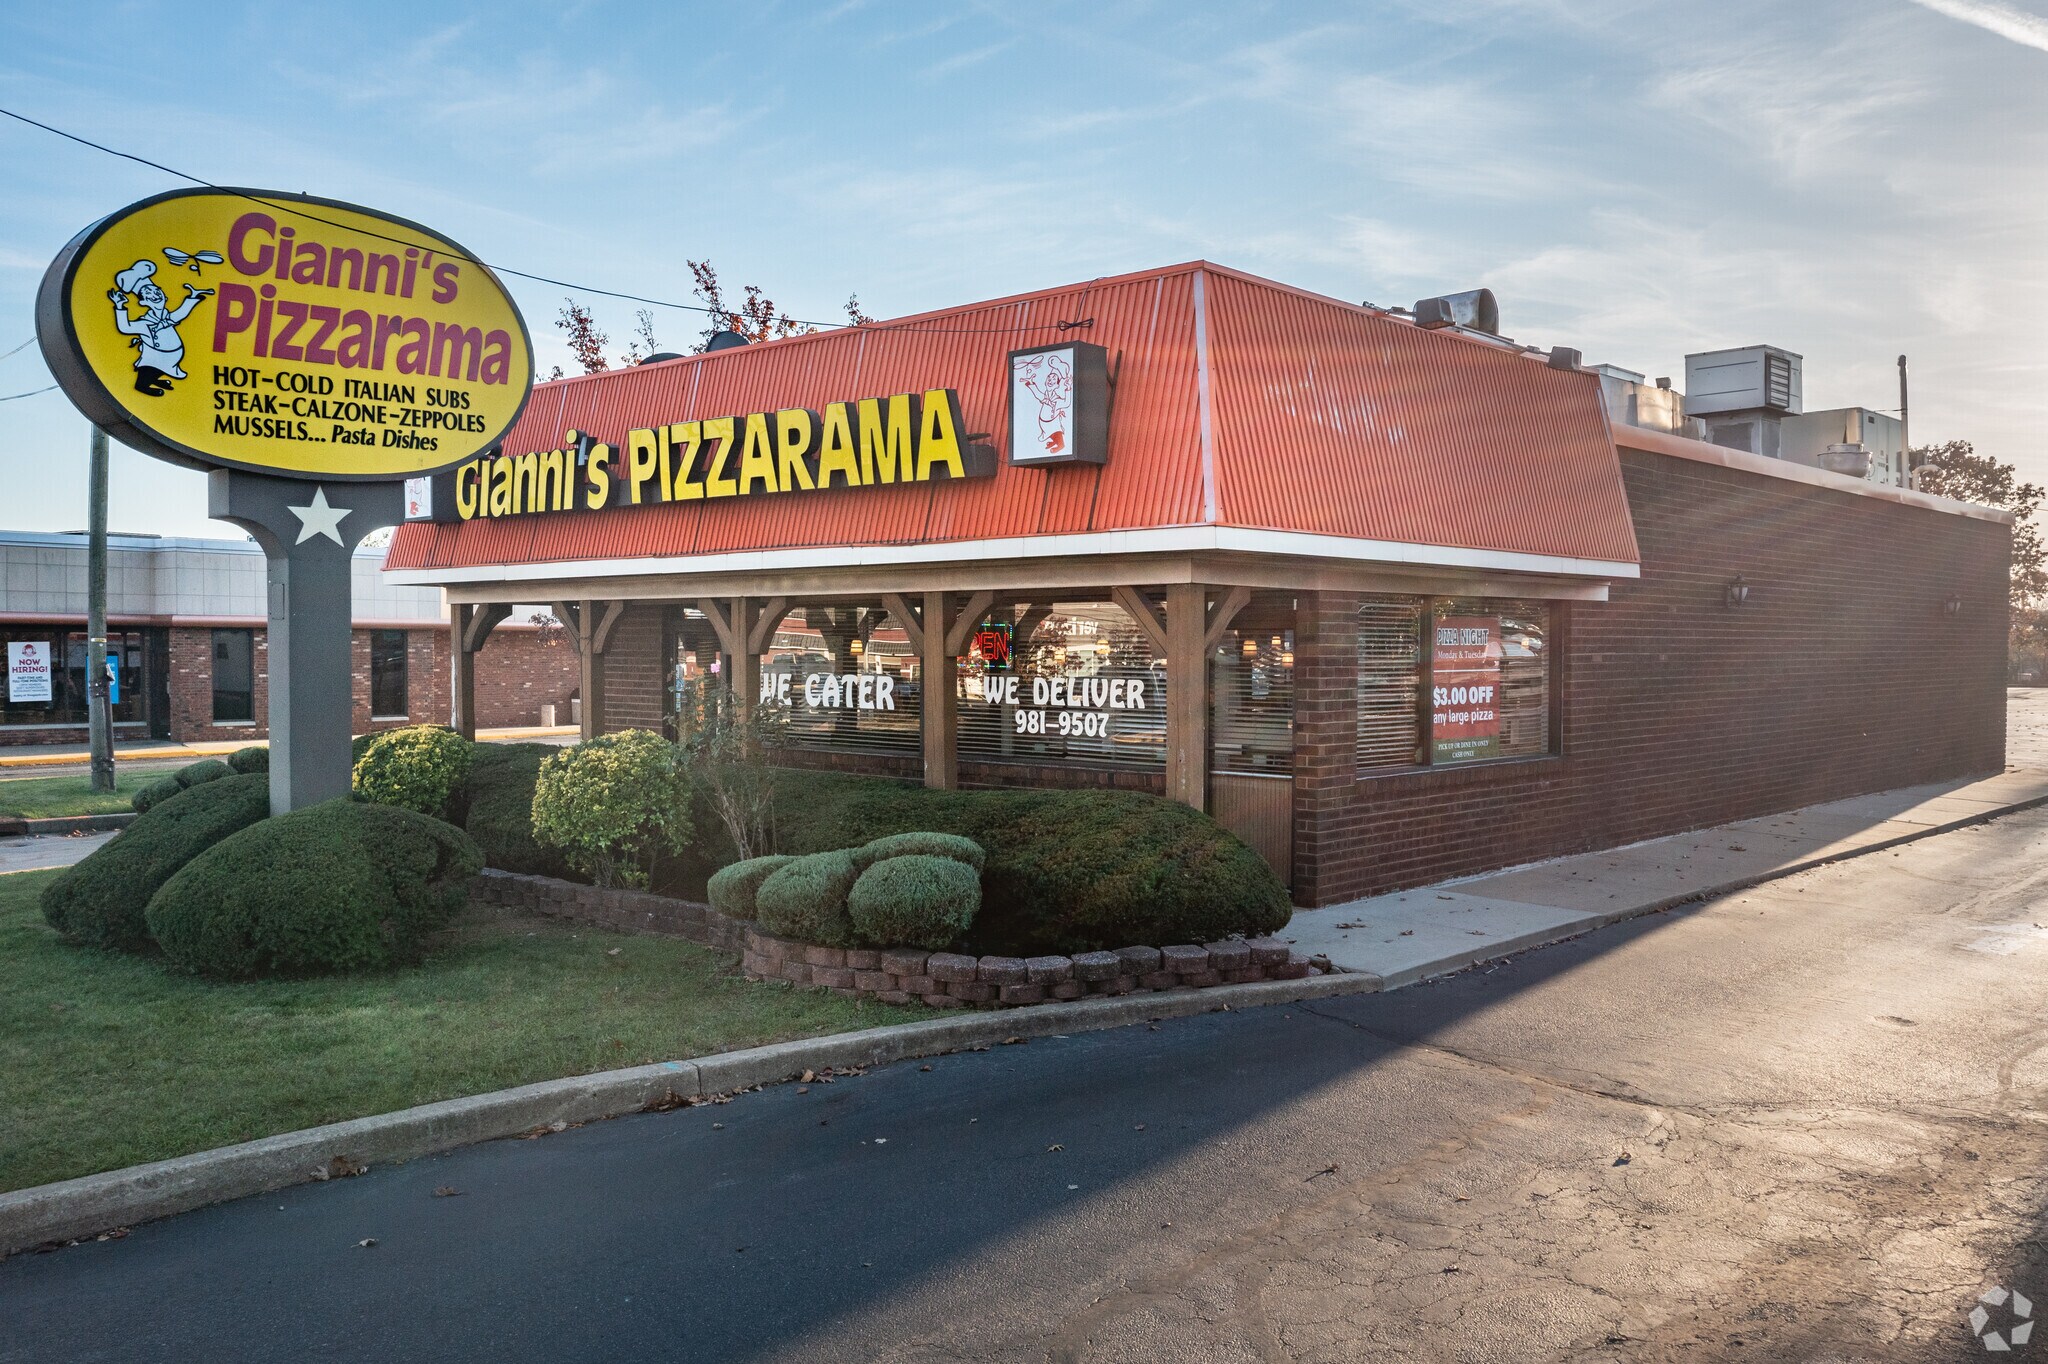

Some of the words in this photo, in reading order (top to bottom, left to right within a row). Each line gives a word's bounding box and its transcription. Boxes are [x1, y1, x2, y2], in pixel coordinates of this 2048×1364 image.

[227, 211, 460, 305] Gianni's
[212, 281, 512, 386] Pizzarama
[213, 365, 334, 396] HOT-COLD
[344, 378, 415, 404] ITALIAN
[426, 388, 471, 410] SUBS
[213, 389, 486, 433] STEAK-CALZONE-ZEPPOLES
[213, 413, 326, 443] MUSSELS...
[331, 424, 376, 446] Pasta
[382, 429, 438, 451] Dishes
[456, 428, 609, 520] Gianni's
[628, 388, 966, 504] PIZZARAMA
[1437, 627, 1459, 646] PIZZA
[1460, 628, 1489, 646] NIGHT
[760, 672, 792, 706] WE
[805, 673, 895, 711] CATER
[983, 676, 1020, 705] WE
[1033, 676, 1146, 709] DELIVER
[1433, 685, 1467, 708] $3.00
[1468, 685, 1494, 704] OFF
[1015, 709, 1110, 738] 981-9507
[1433, 713, 1447, 726] any
[1449, 709, 1469, 725] large
[1471, 707, 1494, 724] pizza
